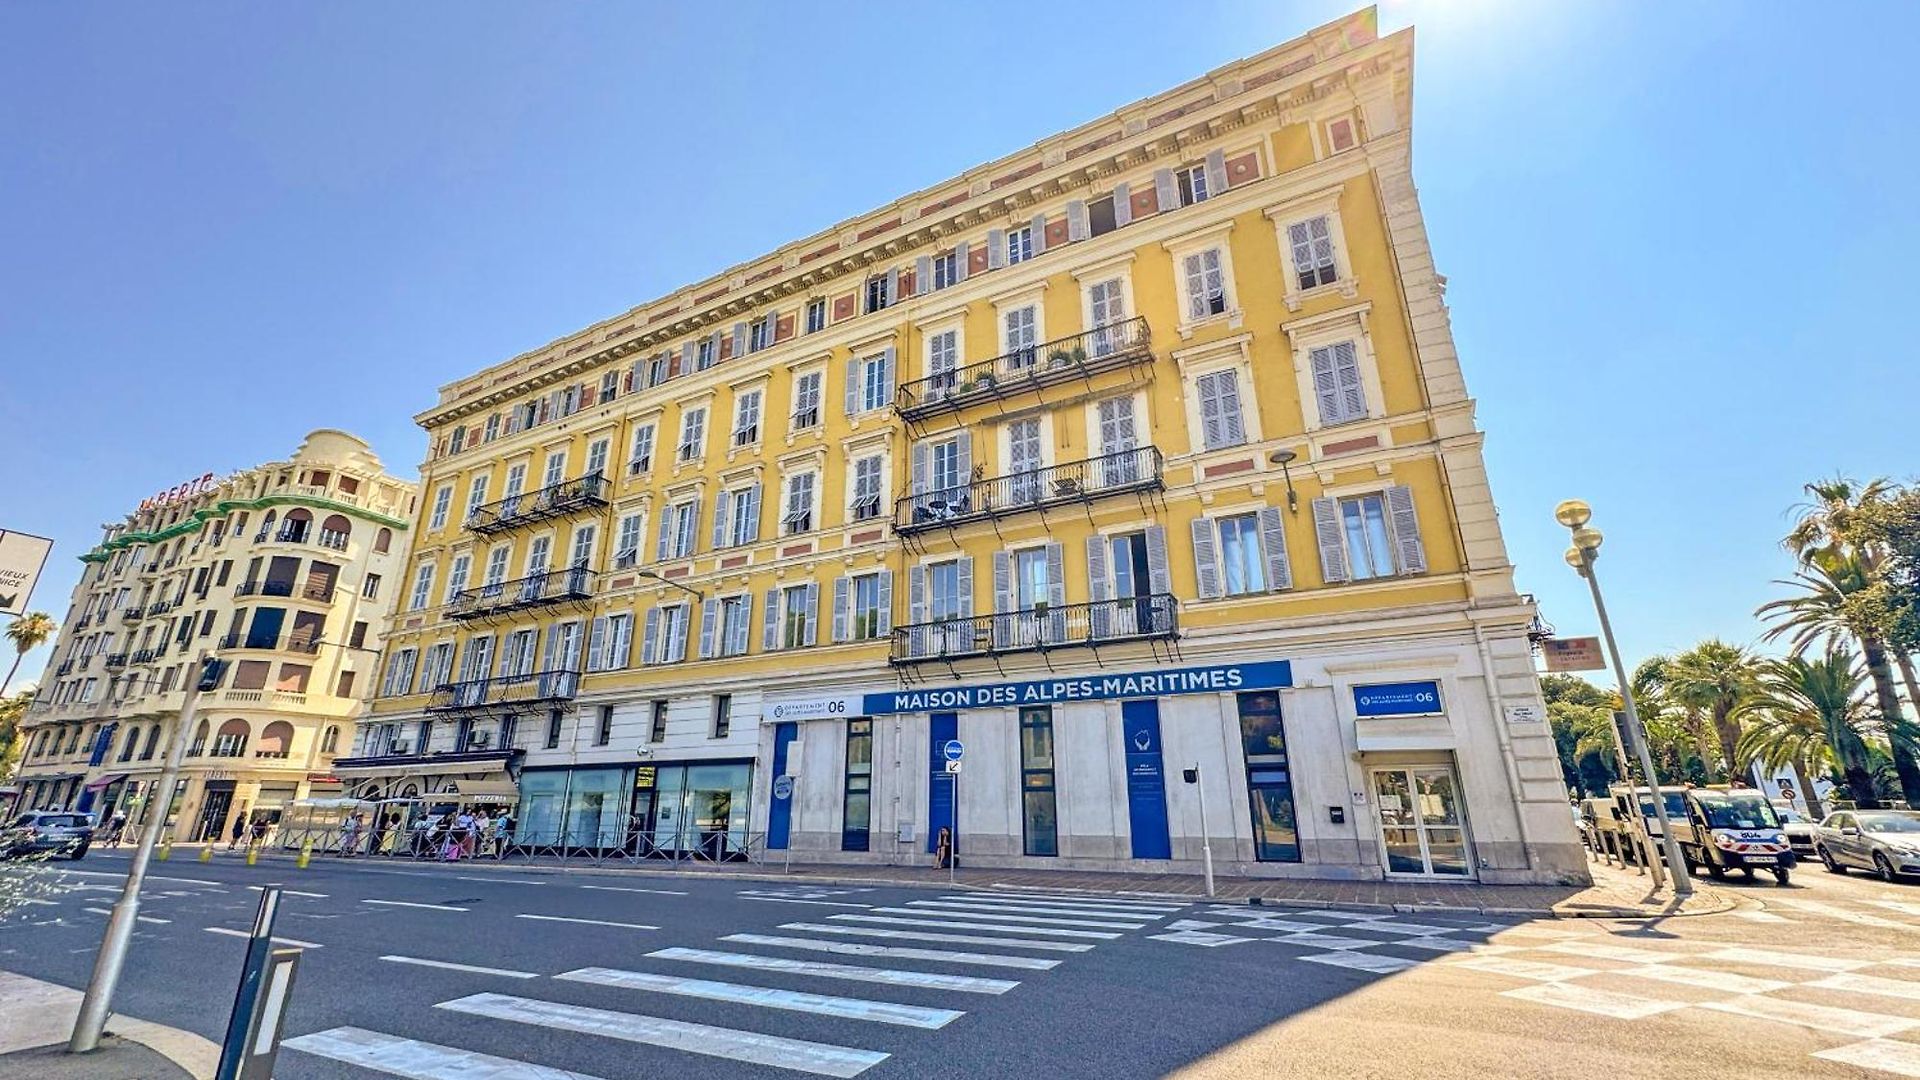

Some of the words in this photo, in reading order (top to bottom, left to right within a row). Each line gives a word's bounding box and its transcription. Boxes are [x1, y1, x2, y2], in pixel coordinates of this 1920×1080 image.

[895, 690, 971, 710] MAISON
[977, 687, 1017, 704] DES
[1023, 668, 1243, 701] ALPES-MARITIMES
[1415, 692, 1434, 703] 06
[828, 701, 846, 713] 06
